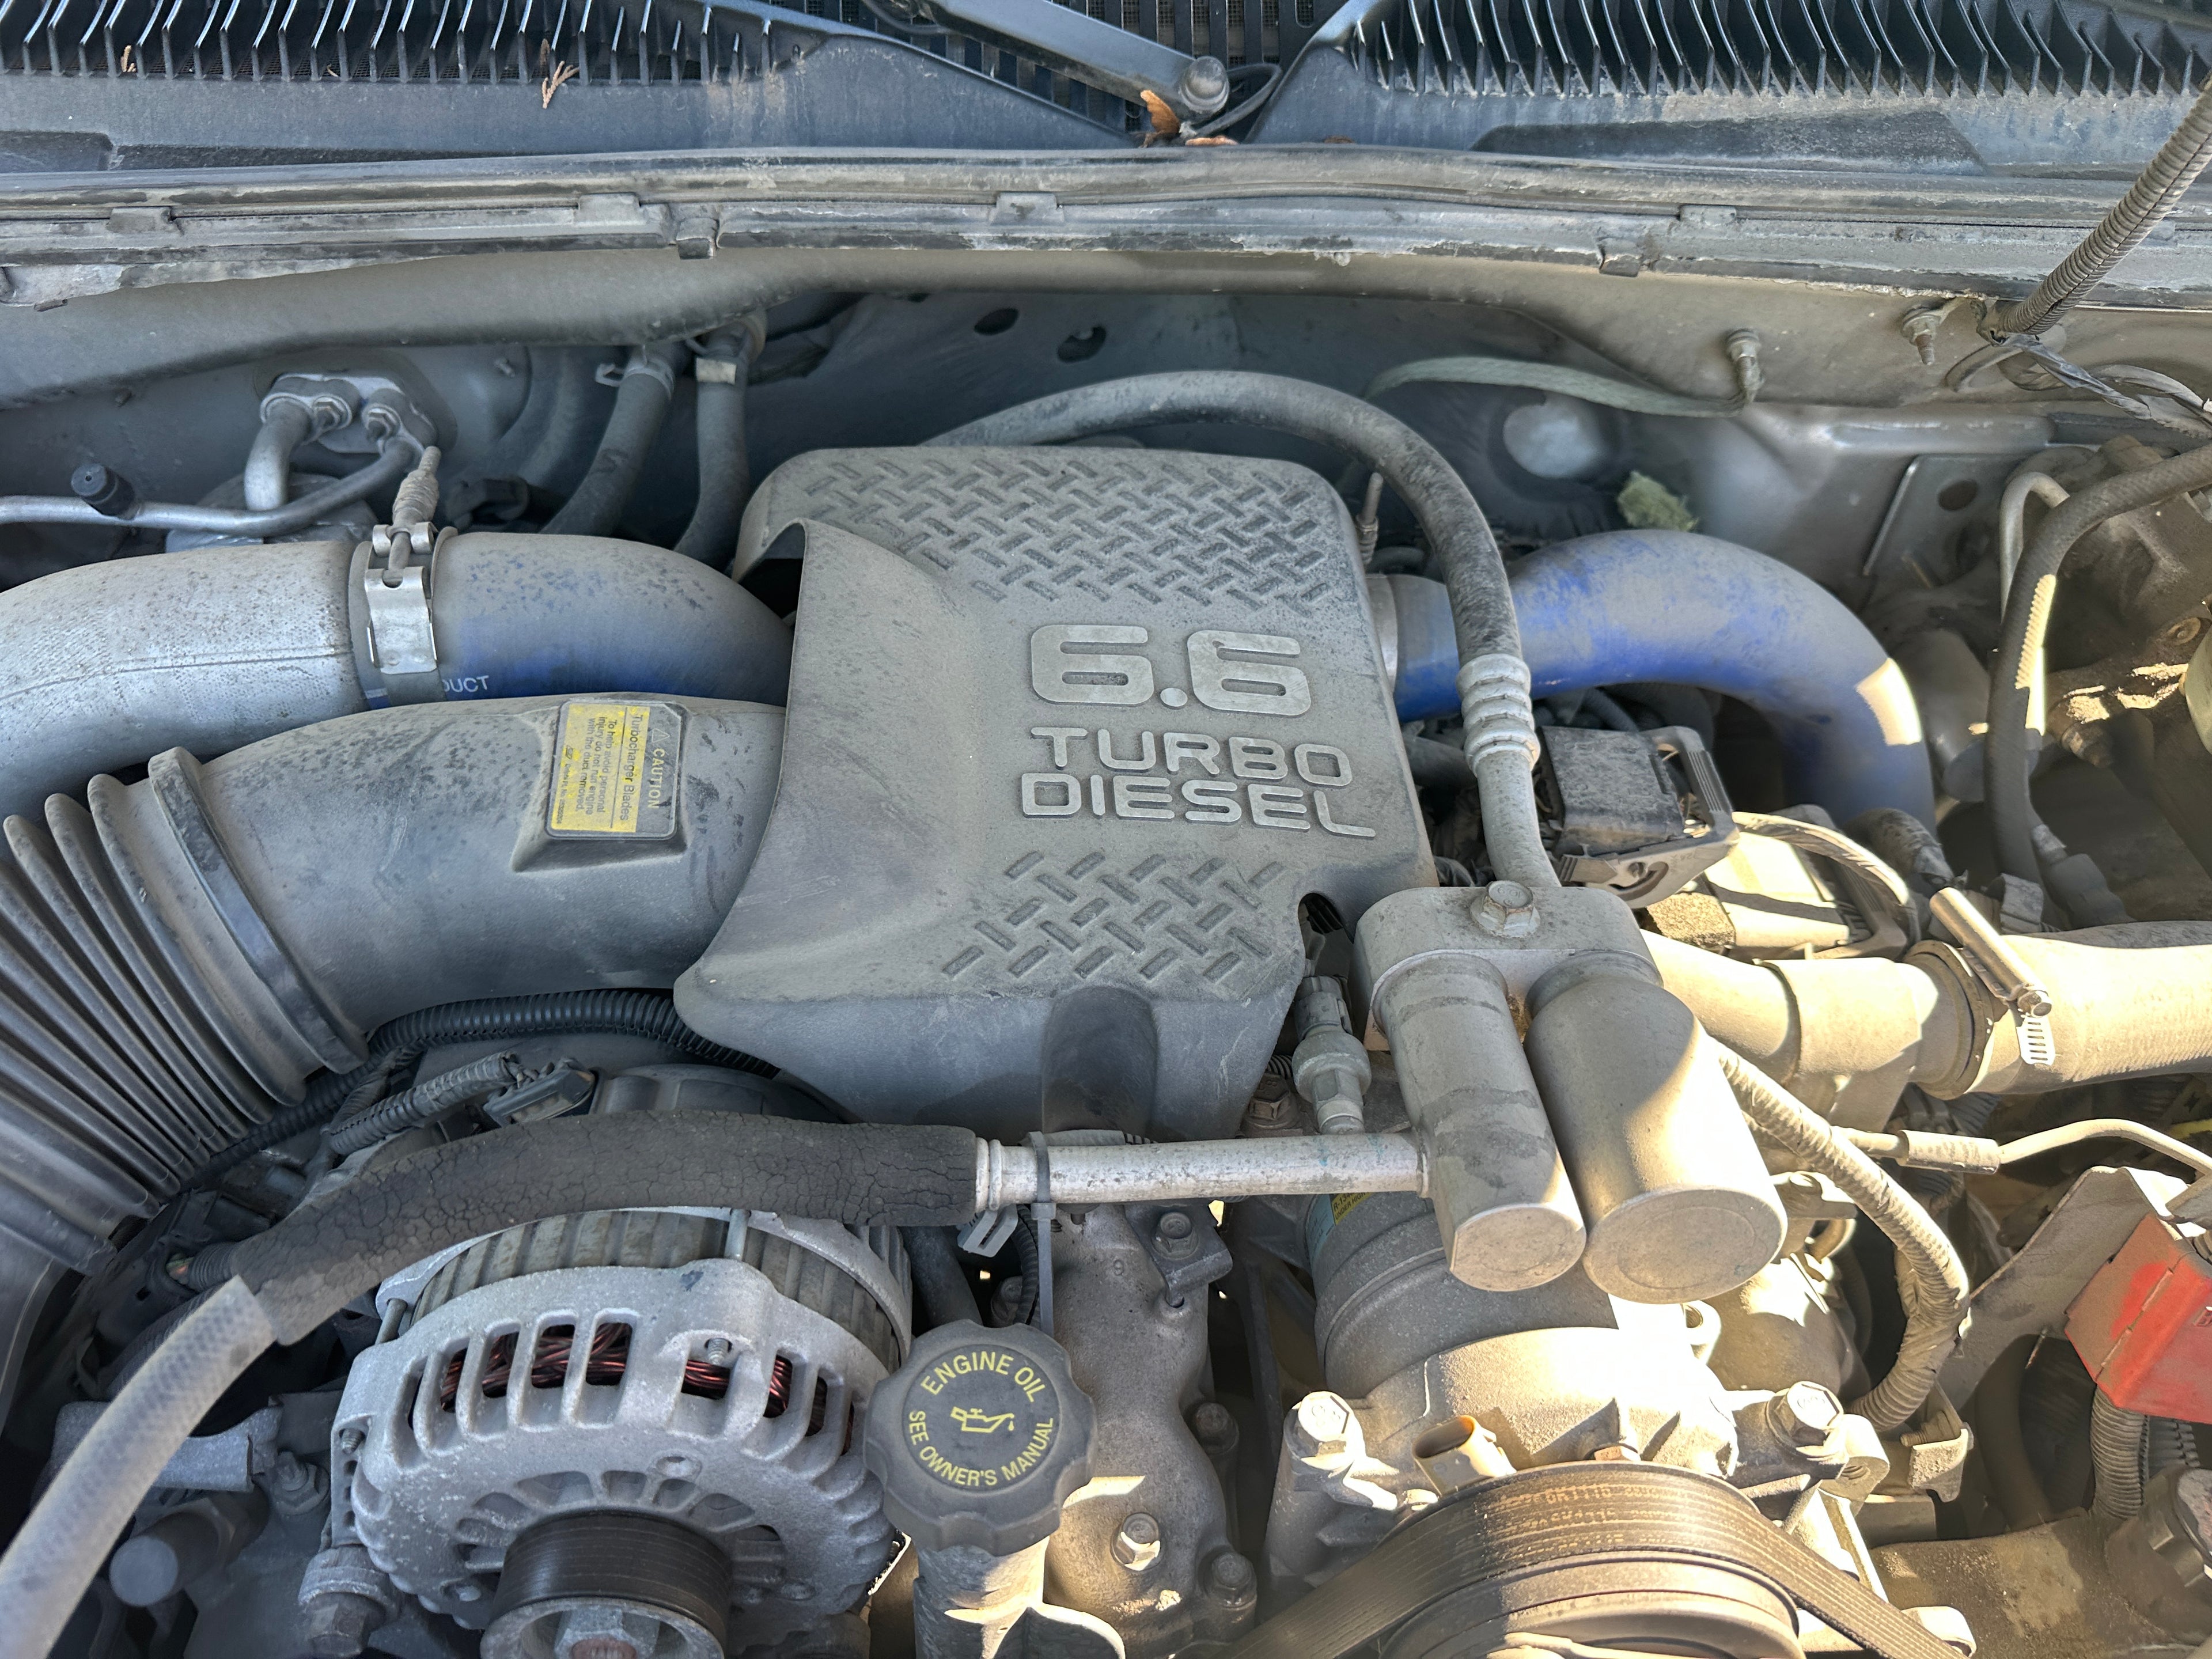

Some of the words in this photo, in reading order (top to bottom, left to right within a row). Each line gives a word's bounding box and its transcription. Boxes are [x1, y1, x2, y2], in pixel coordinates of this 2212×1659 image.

[1031, 624, 1312, 716] 6.6
[587, 718, 596, 737] with
[596, 717, 607, 740] injury
[608, 719, 617, 729] To
[585, 737, 594, 749] the
[594, 741, 603, 751] do
[606, 732, 616, 749] help
[624, 714, 643, 782] Turbocharger
[582, 751, 592, 771] duct
[593, 753, 601, 766] not
[602, 751, 612, 774] avoid
[1031, 727, 1352, 787] TURBO
[590, 768, 599, 784] run
[648, 749, 665, 809] CAUTION
[575, 772, 588, 812] removed.
[585, 785, 597, 815] engine
[597, 775, 609, 813] personal
[620, 785, 634, 821] Blades
[1021, 772, 1376, 838] DIESEL
[1335, 1200, 1351, 1220] UNDER
[921, 1351, 1014, 1396] ENGINE
[1014, 1366, 1046, 1402] OIL
[909, 1410, 929, 1445] SEE
[920, 1445, 998, 1487] OWNER'S
[1001, 1418, 1054, 1481] MANUAL
